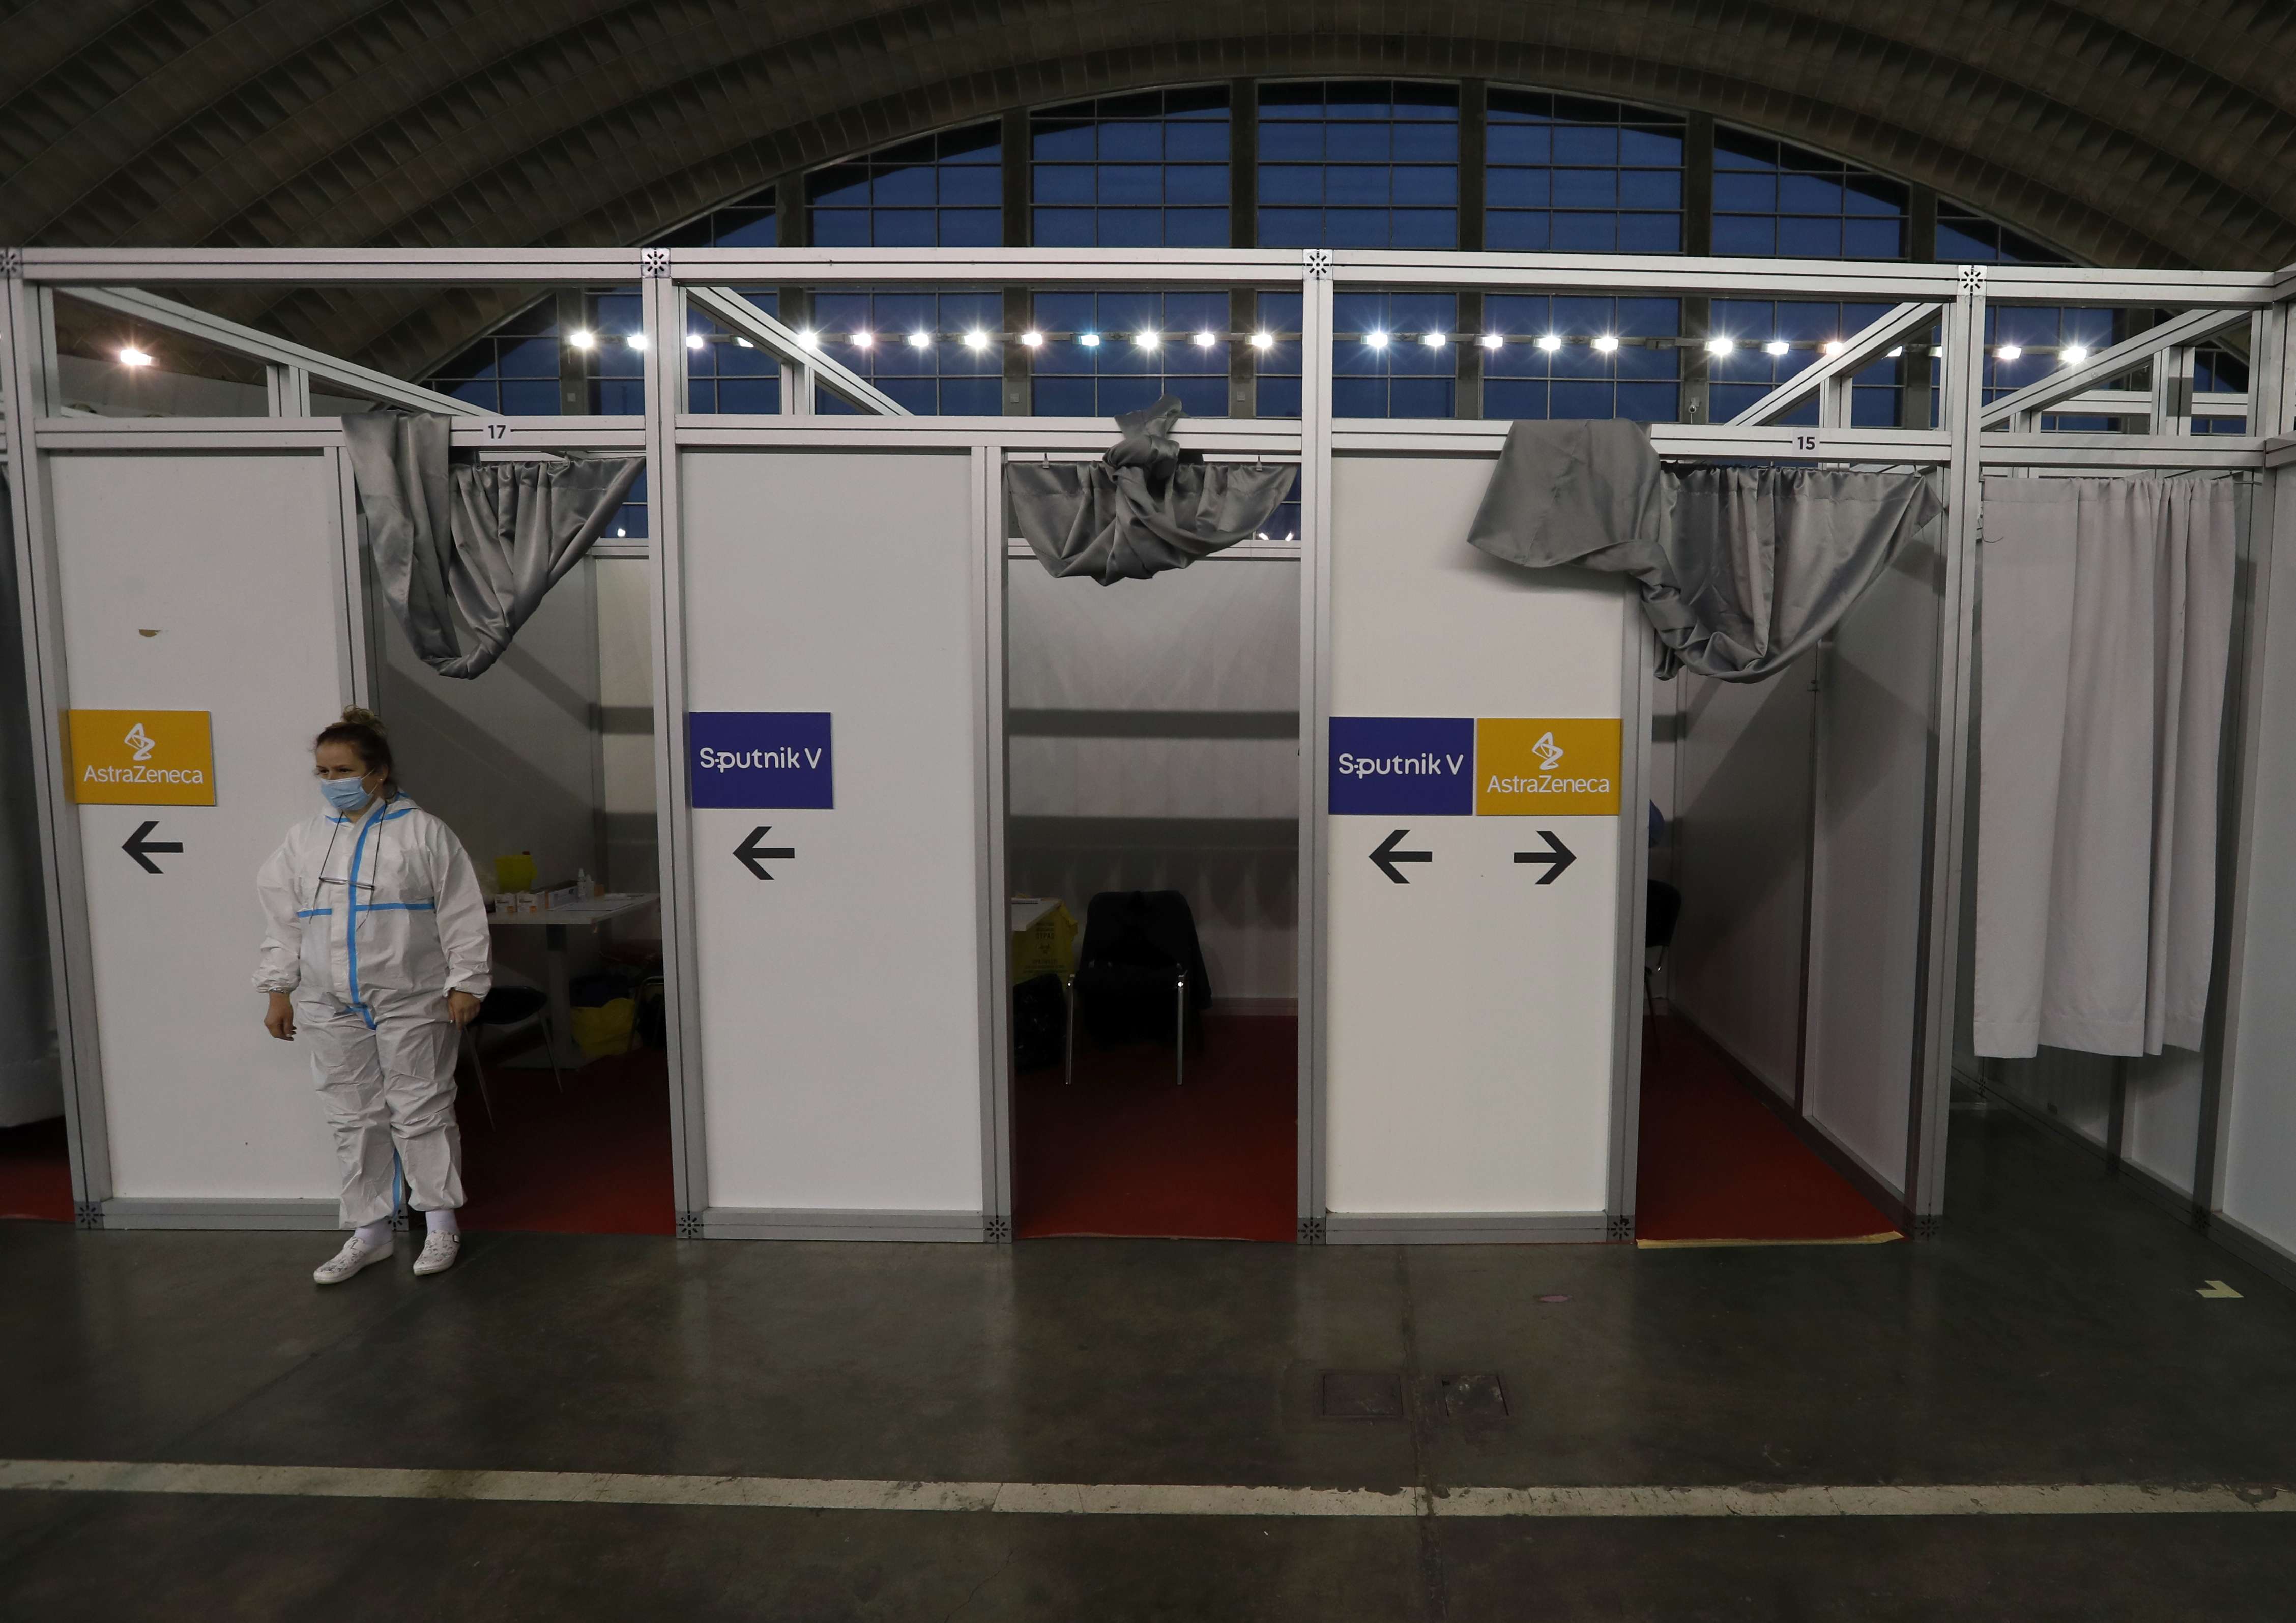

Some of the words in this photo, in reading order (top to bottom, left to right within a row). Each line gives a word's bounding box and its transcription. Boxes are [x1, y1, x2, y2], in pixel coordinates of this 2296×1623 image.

[488, 424, 506, 439] 17
[1797, 436, 1816, 450] 15
[700, 746, 800, 773] Sputnik
[804, 747, 822, 769] V
[1339, 752, 1441, 779] Sputnik
[1446, 753, 1464, 775] V
[83, 765, 204, 784] AstraZeneca
[1486, 774, 1610, 793] AstraZeneca
